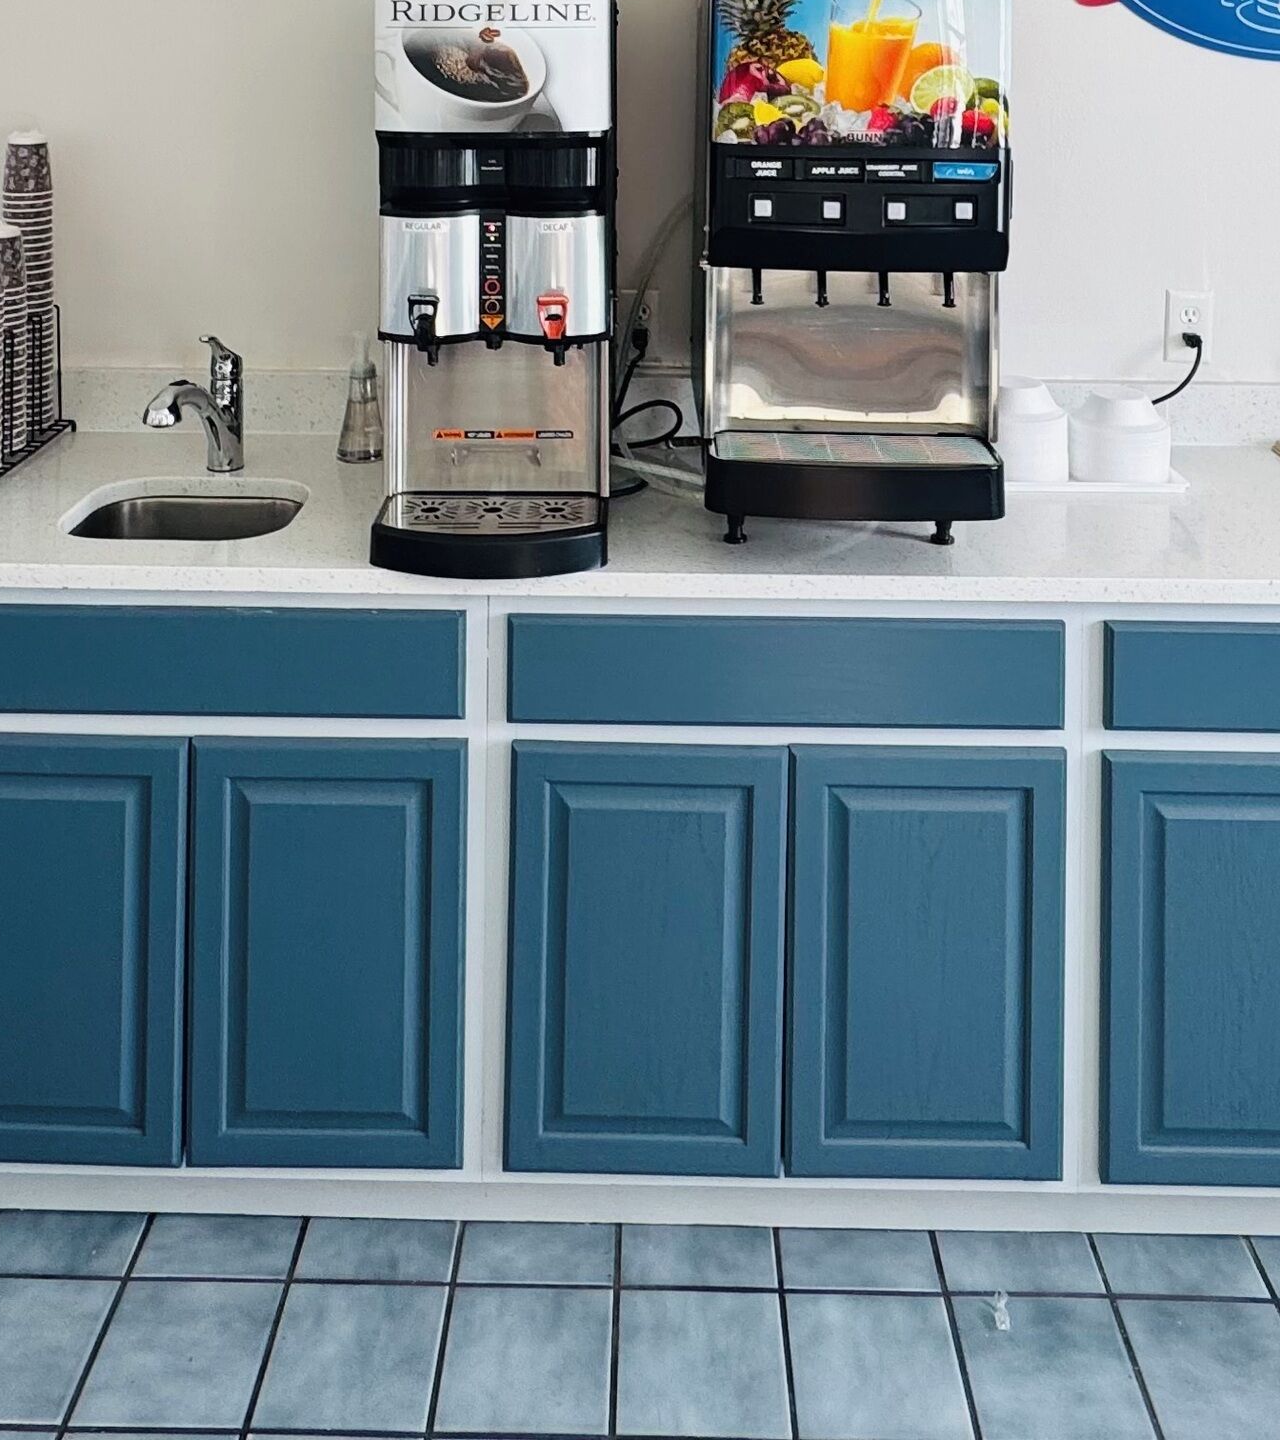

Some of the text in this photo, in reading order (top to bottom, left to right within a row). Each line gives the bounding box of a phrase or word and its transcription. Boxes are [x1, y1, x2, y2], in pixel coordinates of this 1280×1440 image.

[391, 0, 593, 22] RIDGELINE
[846, 132, 882, 142] BUNN
[751, 161, 782, 169] ORANGE
[811, 167, 859, 175] APPLE JUICE
[404, 221, 442, 230] REGULAR
[543, 222, 569, 231] DECAF
